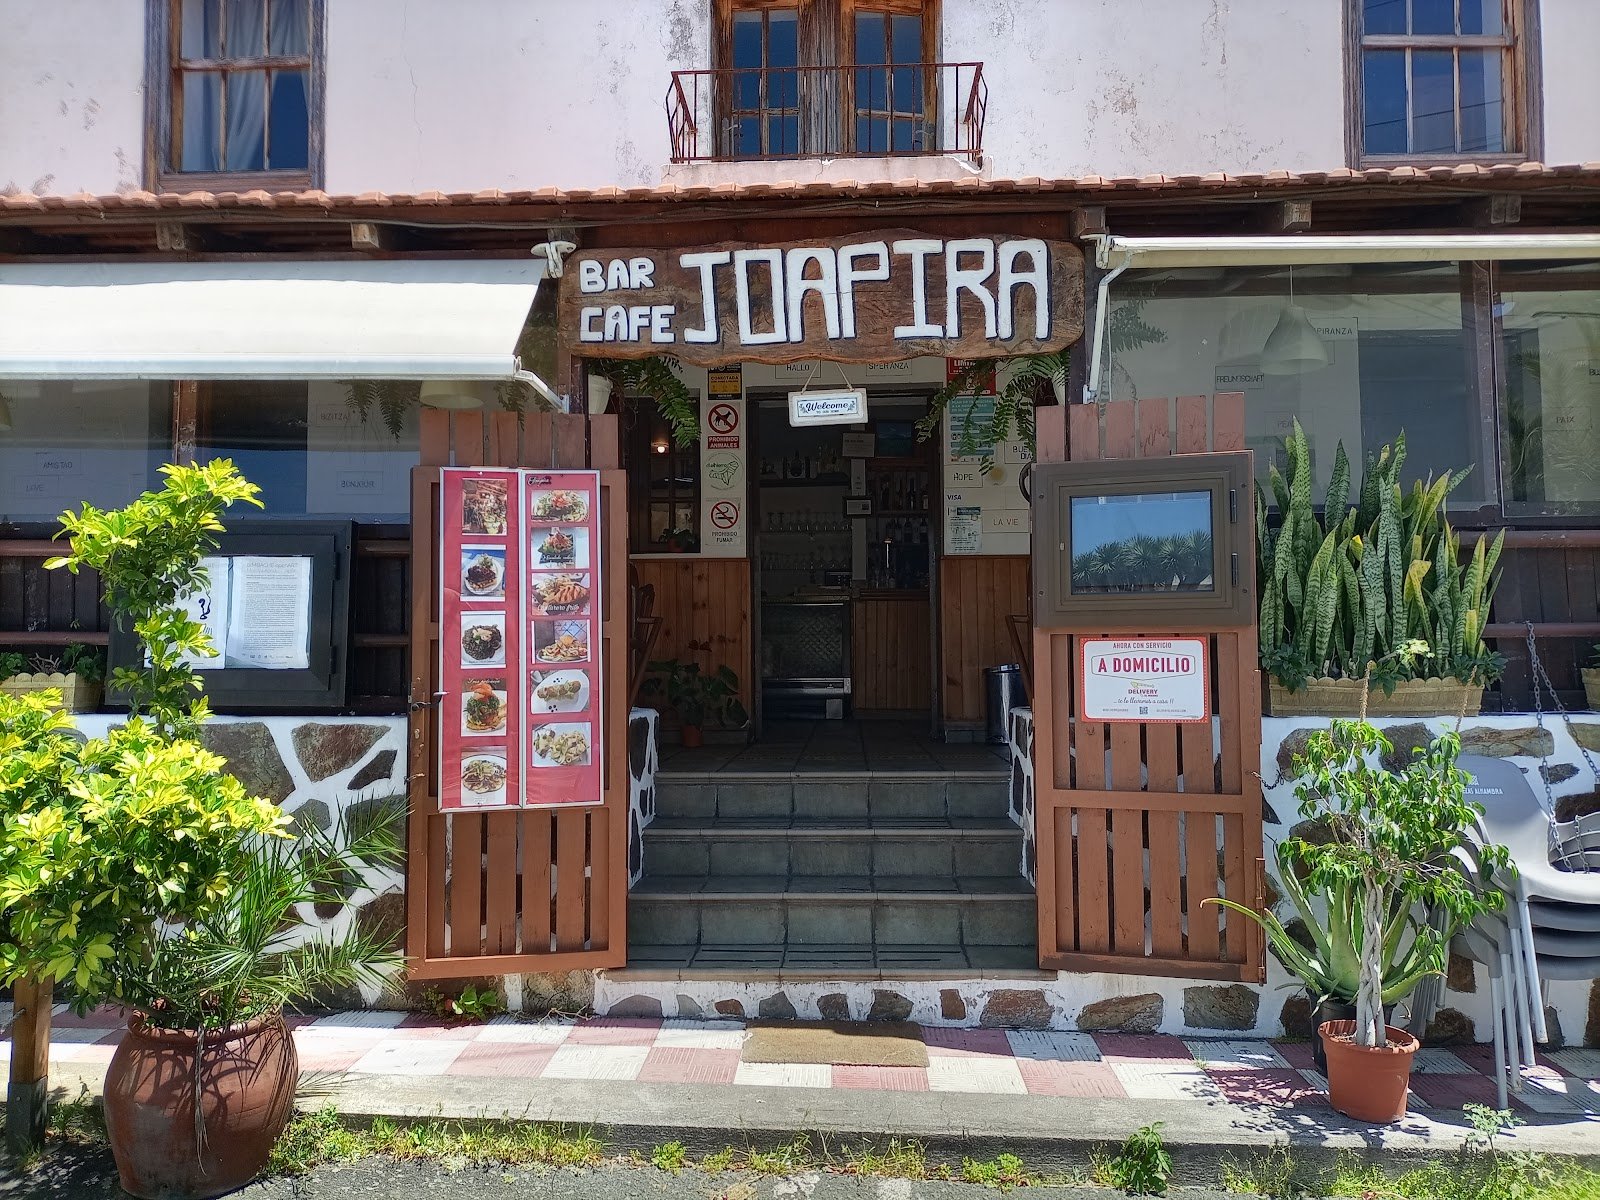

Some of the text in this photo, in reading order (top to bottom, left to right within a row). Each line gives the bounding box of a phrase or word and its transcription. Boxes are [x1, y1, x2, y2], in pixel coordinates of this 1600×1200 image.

[579, 257, 655, 293] BAR
[679, 238, 1051, 345] JOAPIRA
[580, 305, 676, 343] CAFE
[786, 363, 810, 372] HALLO
[805, 401, 849, 412] Welcome
[1556, 416, 1575, 424] PAIX
[953, 473, 974, 481] HOPE
[993, 518, 1019, 526] LA VIE
[1097, 657, 1190, 673] A DOMICILIO
